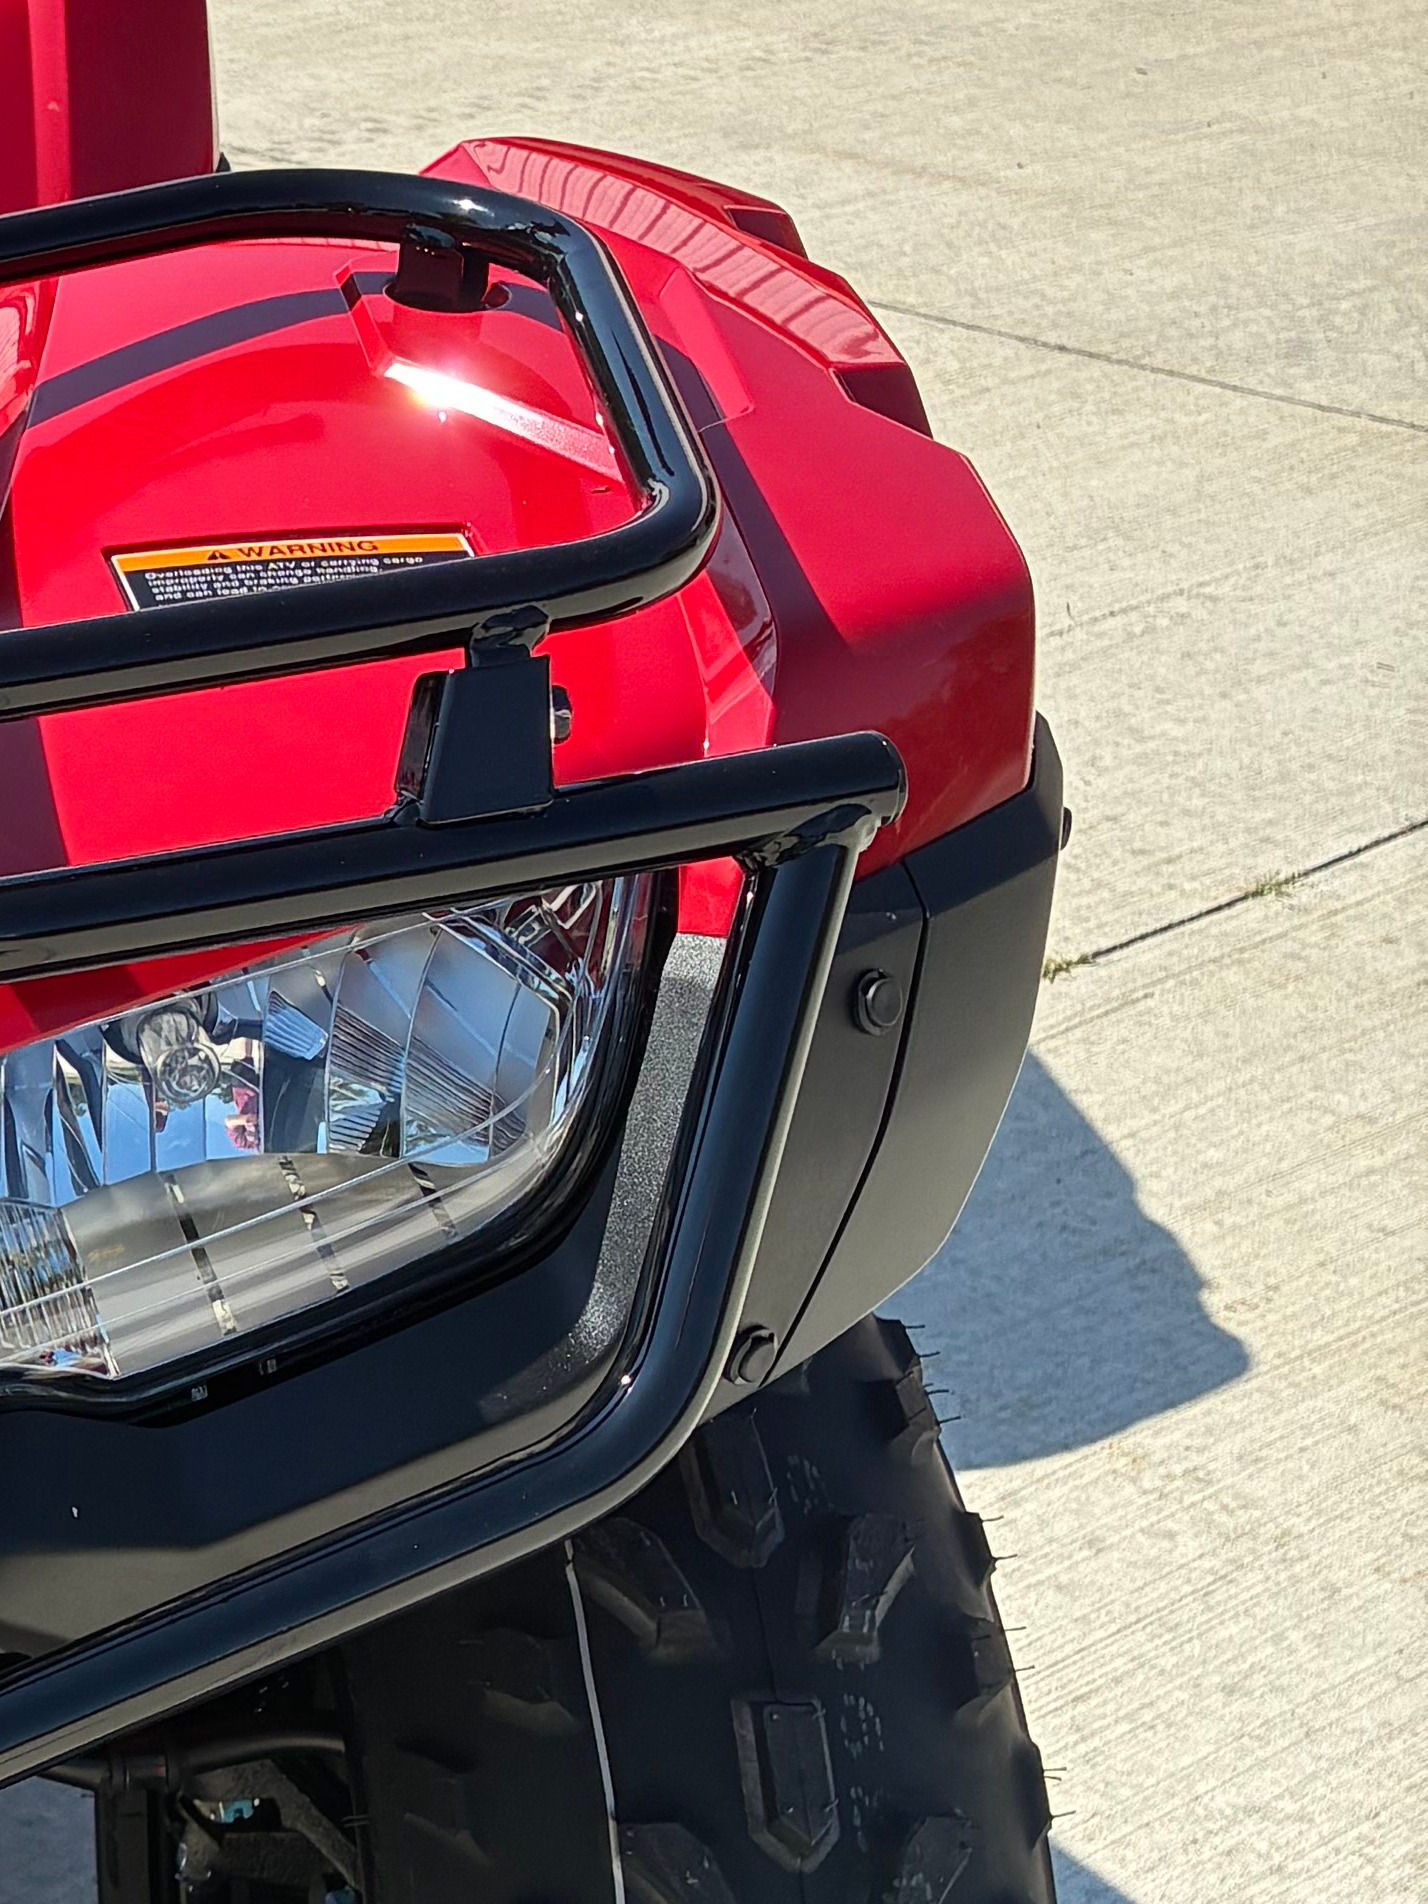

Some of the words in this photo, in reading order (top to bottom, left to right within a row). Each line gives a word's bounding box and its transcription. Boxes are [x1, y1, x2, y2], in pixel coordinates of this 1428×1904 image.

[238, 540, 379, 558] WARNING
[145, 566, 232, 580] Overloading
[236, 564, 263, 573] this
[268, 560, 295, 570] ATV
[320, 558, 380, 568] carrying
[383, 556, 423, 565] cargo
[148, 574, 224, 587] improperly
[229, 572, 255, 580] can
[152, 583, 208, 594] stability
[213, 580, 239, 589] and
[244, 576, 299, 586] braking
[155, 592, 182, 601] and
[186, 589, 212, 597] can
